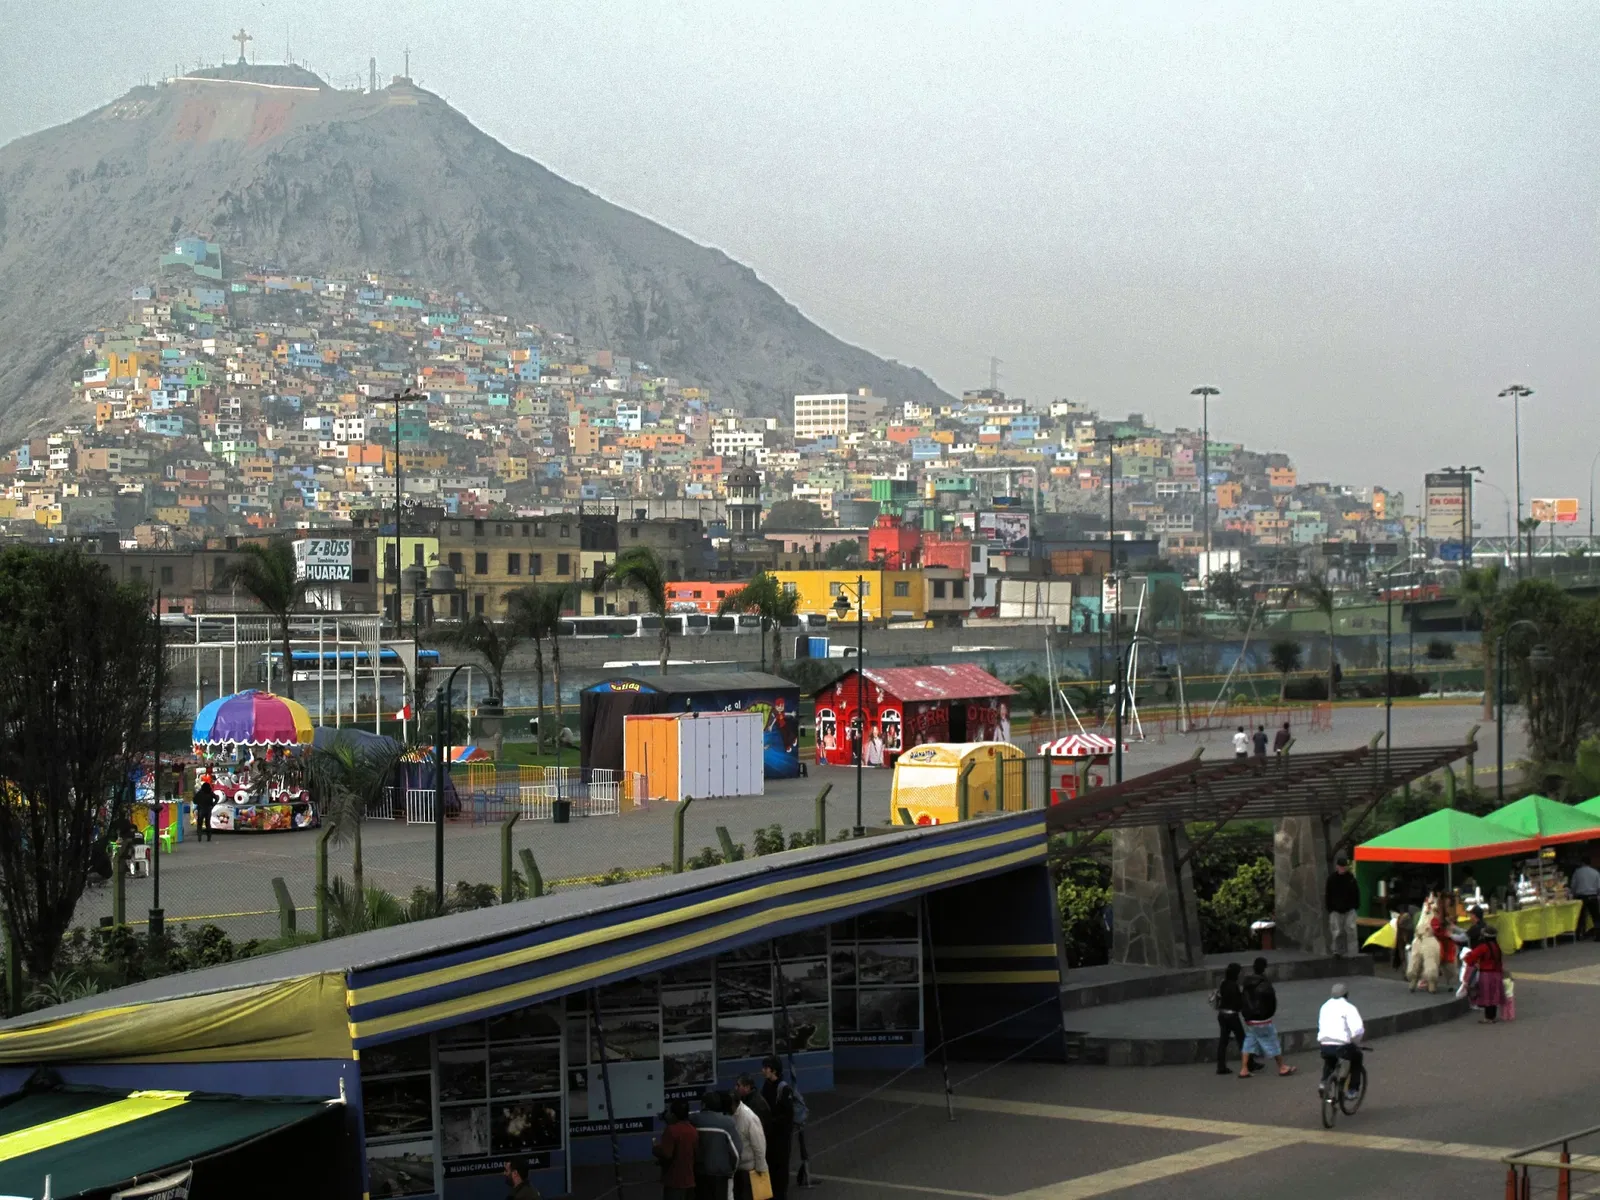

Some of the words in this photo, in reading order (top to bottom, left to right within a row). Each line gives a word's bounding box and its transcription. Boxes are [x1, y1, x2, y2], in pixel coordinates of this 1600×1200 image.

[306, 566, 350, 580] HUARAZ
[681, 1090, 697, 1098] LIMA
[614, 1122, 624, 1130] DE
[625, 1121, 643, 1129] LIMA
[450, 1160, 506, 1173] MUNICIPALIDA
